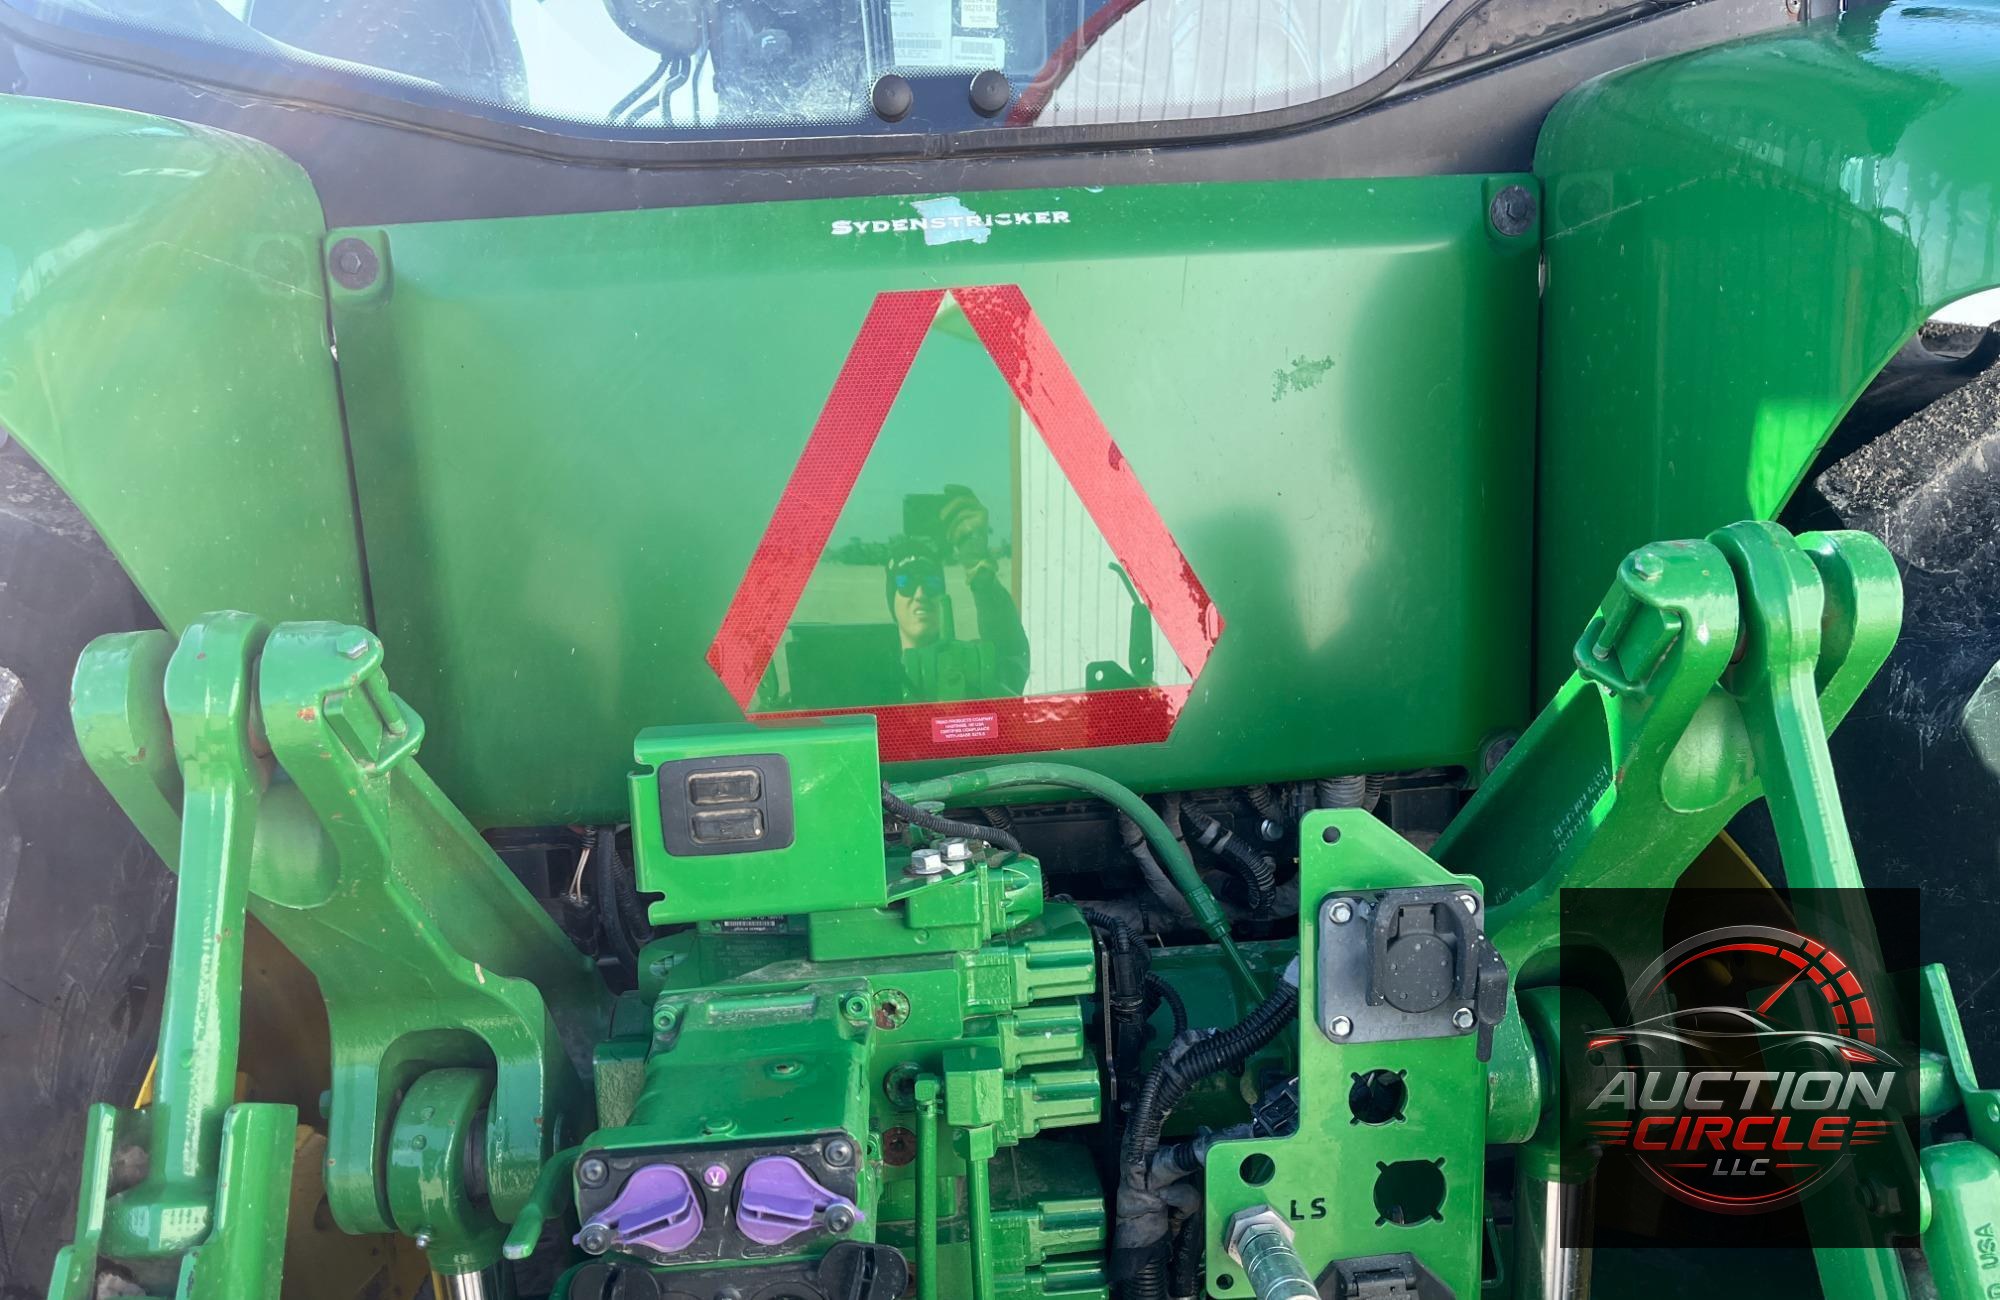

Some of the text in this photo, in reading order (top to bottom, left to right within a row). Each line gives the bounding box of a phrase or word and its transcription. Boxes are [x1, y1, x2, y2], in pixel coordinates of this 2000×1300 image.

[831, 211, 1071, 235] SYDENSTRICKER
[1290, 1198, 1327, 1220] LS
[1974, 1222, 1999, 1270] USA
